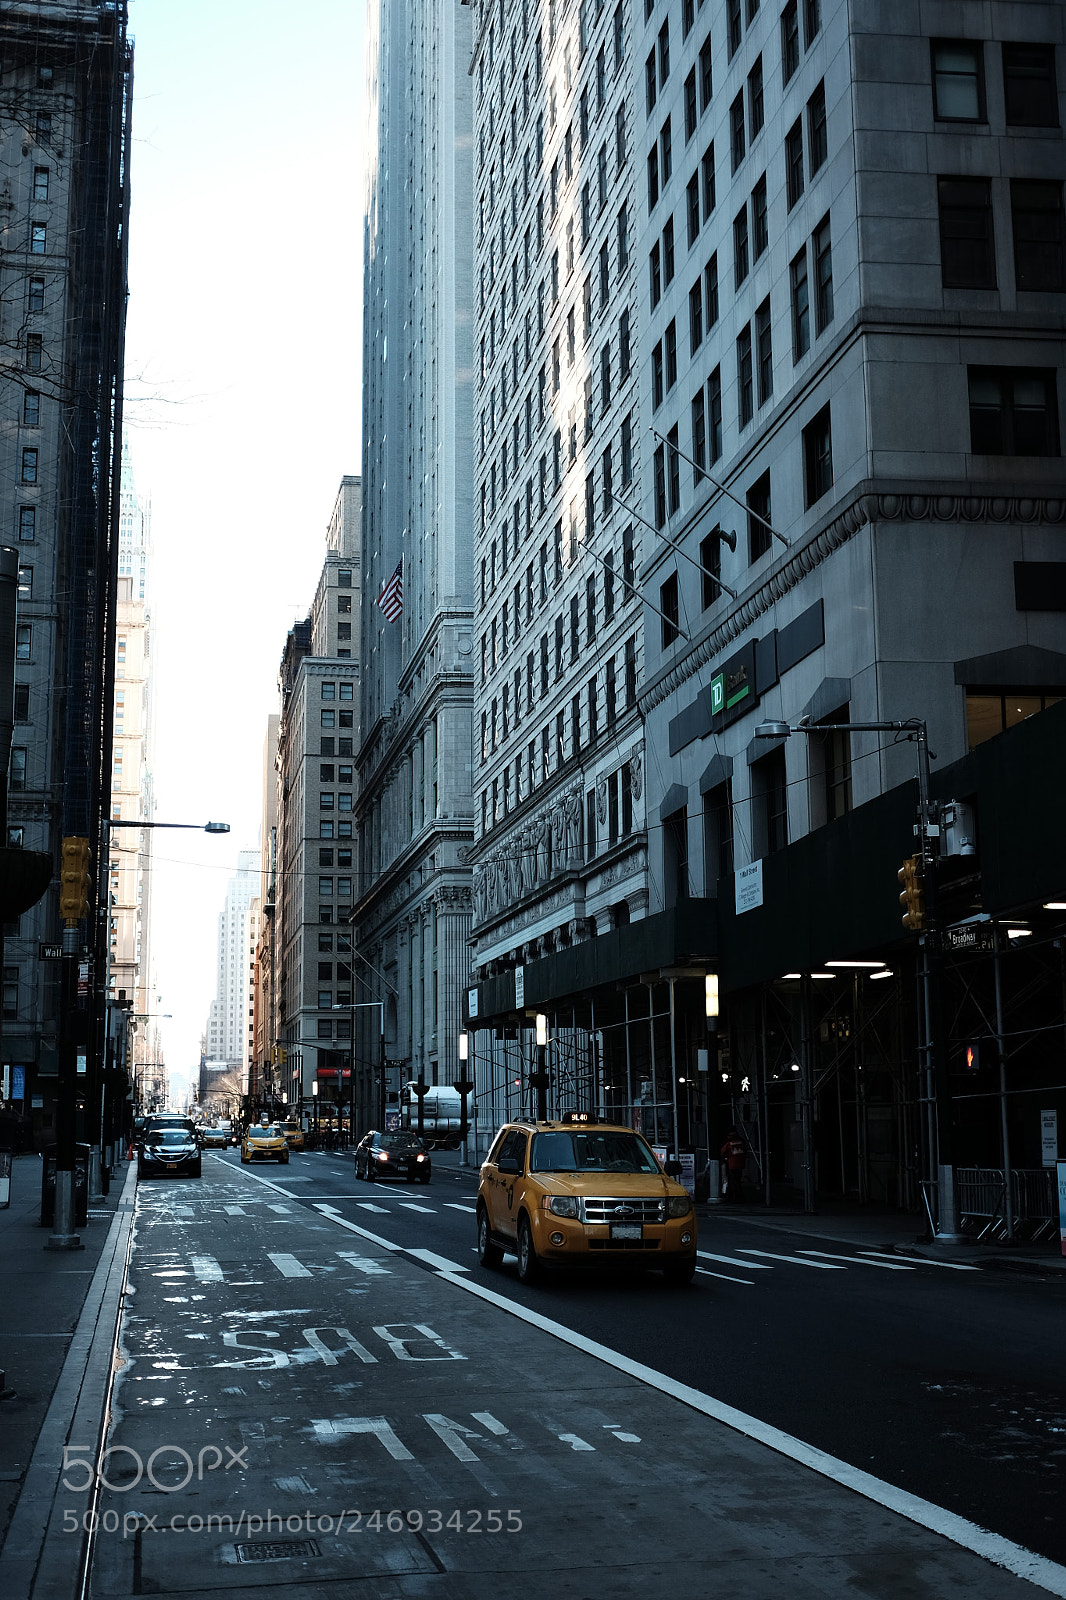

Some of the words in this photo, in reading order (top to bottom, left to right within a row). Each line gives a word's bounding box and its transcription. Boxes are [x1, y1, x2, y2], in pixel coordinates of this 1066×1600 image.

[712, 682, 722, 706] TD
[952, 932, 976, 945] Broadway
[44, 947, 62, 958] Wall
[571, 1113, 588, 1121] 9L40
[218, 1323, 468, 1369] BUS
